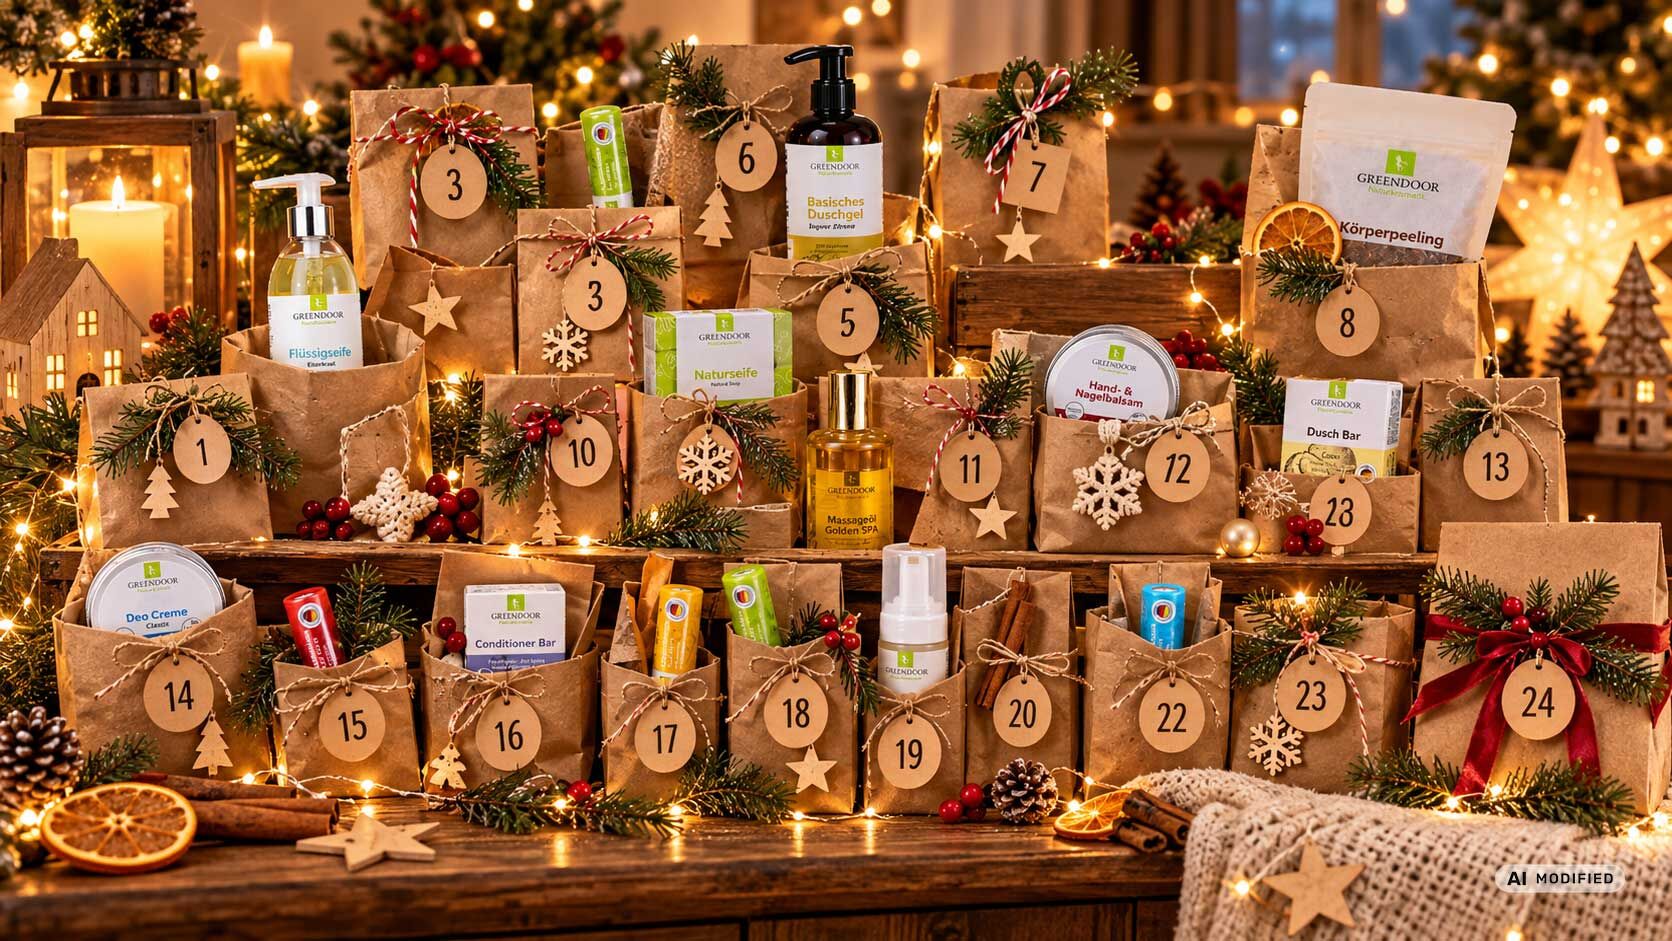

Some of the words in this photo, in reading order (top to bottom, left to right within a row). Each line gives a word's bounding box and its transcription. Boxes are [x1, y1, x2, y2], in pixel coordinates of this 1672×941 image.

[738, 142, 756, 175] 6
[446, 168, 463, 201] 3
[1030, 160, 1047, 193] 7
[1357, 172, 1440, 193] GREENDOOR
[808, 197, 864, 207] Basisches
[808, 208, 864, 221] Duschgel
[1340, 221, 1444, 250] Körperpeeling
[587, 280, 603, 312] 3
[292, 311, 344, 320] GREENDOOR
[840, 307, 856, 337] 5
[1339, 307, 1355, 338] 8
[698, 332, 751, 341] GREENDOOR
[289, 346, 352, 360] Flüssigseife
[1092, 359, 1137, 372] GREENDOOR
[694, 367, 758, 380] Naturseife
[1089, 380, 1122, 393] Hand-
[1124, 386, 1133, 396] &
[1075, 388, 1144, 409] Nagelbalsam
[1310, 398, 1361, 409] GREENDOOR
[1307, 426, 1340, 439] Dusch
[1342, 430, 1361, 441] Bar
[196, 438, 208, 466] 1
[568, 437, 597, 469] 10
[1482, 451, 1510, 482] 13
[959, 454, 981, 485] 11
[1164, 453, 1192, 485] 12
[825, 526, 859, 535] Golden
[862, 526, 879, 534] SPA
[827, 514, 876, 525] Massageöl
[128, 578, 179, 589] GREENDOOR
[126, 613, 148, 623] Deo
[151, 608, 188, 621] Creme
[490, 612, 541, 620] GREENDOOR
[475, 640, 535, 649] Conditioner
[538, 638, 556, 648] Bar
[164, 679, 195, 712] 14
[1295, 679, 1327, 712] 23
[1521, 686, 1555, 718] 24
[337, 709, 368, 742] 15
[782, 697, 810, 729] 18
[1008, 698, 1037, 729] 20
[1157, 702, 1187, 733] 22
[494, 719, 524, 752] 16
[652, 723, 678, 754] 17
[895, 738, 923, 770] 19
